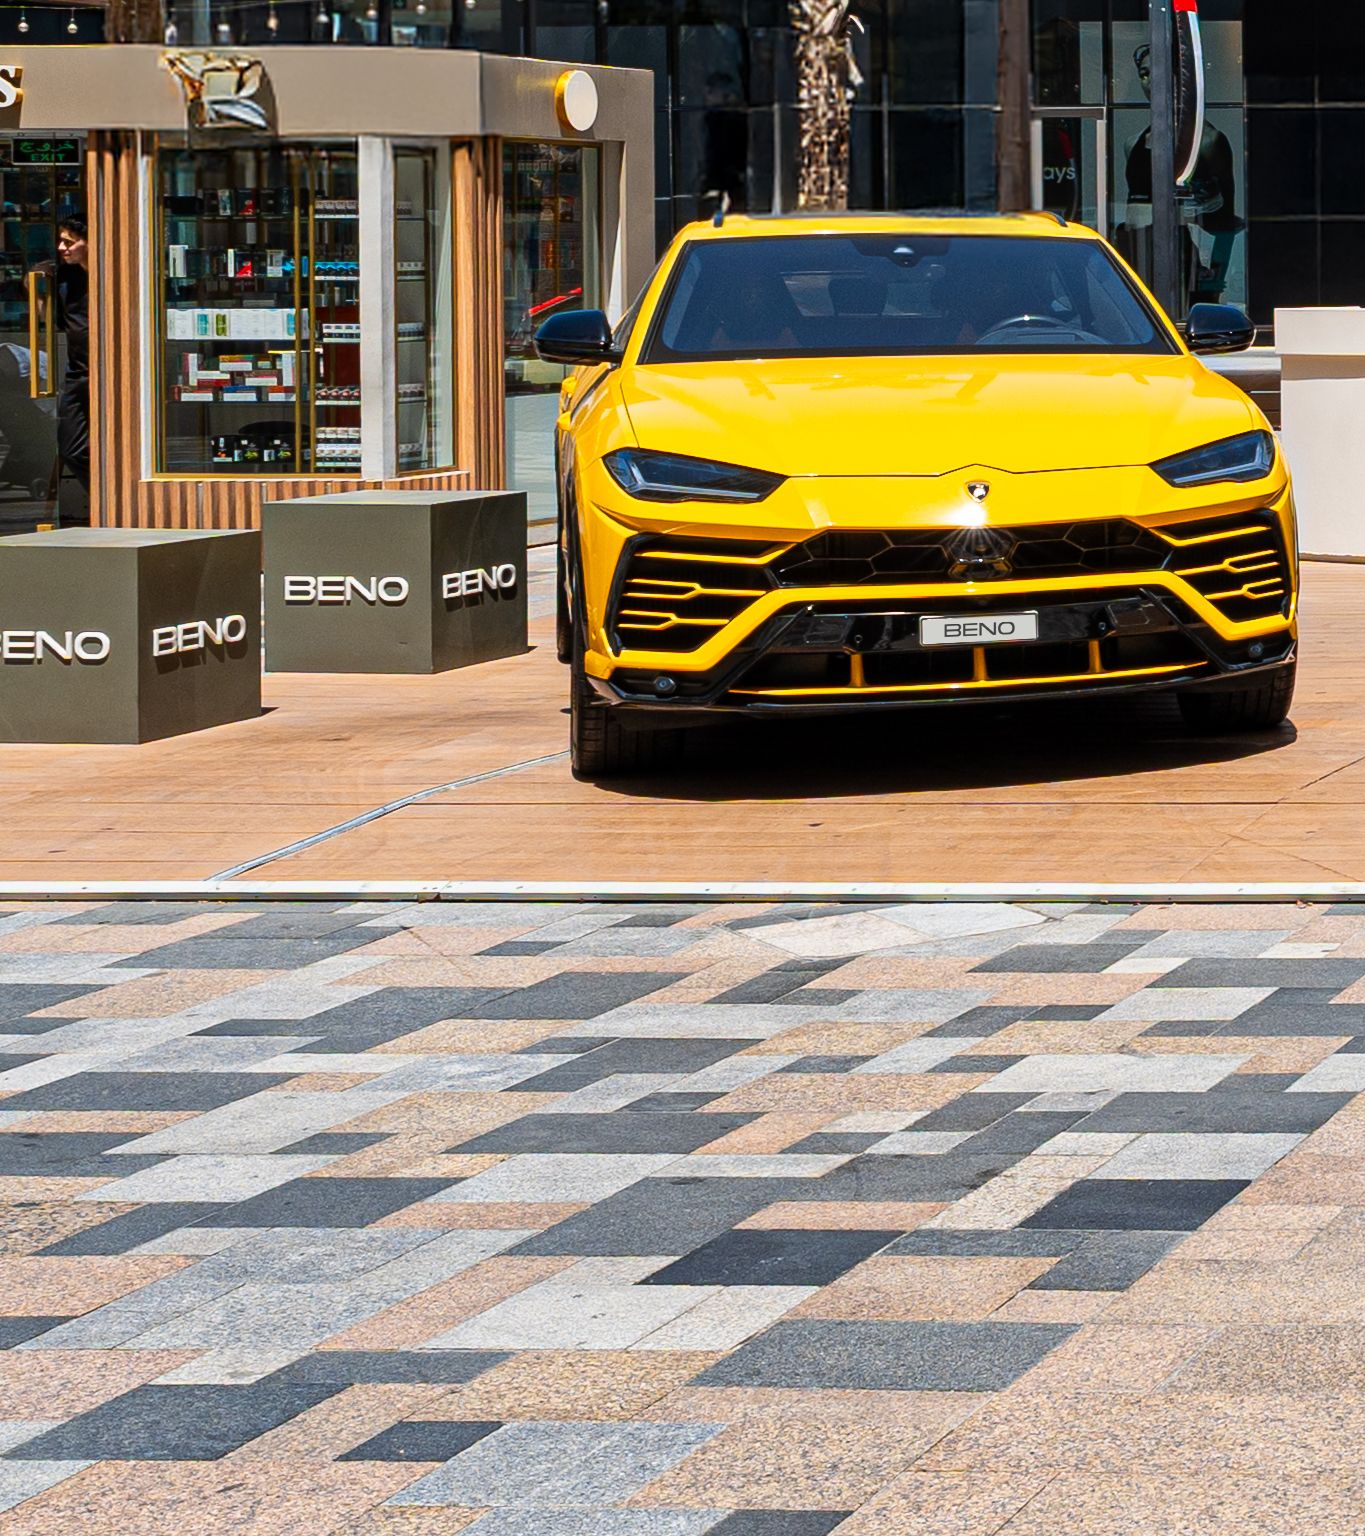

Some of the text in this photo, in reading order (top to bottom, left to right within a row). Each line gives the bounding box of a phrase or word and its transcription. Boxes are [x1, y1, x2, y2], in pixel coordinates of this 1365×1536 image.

[31, 153, 66, 161] EXIT
[284, 575, 410, 602] BENO
[442, 563, 517, 599] BENO
[152, 614, 247, 657] BENO
[944, 621, 1015, 638] BENO
[0, 630, 111, 660] ENO
